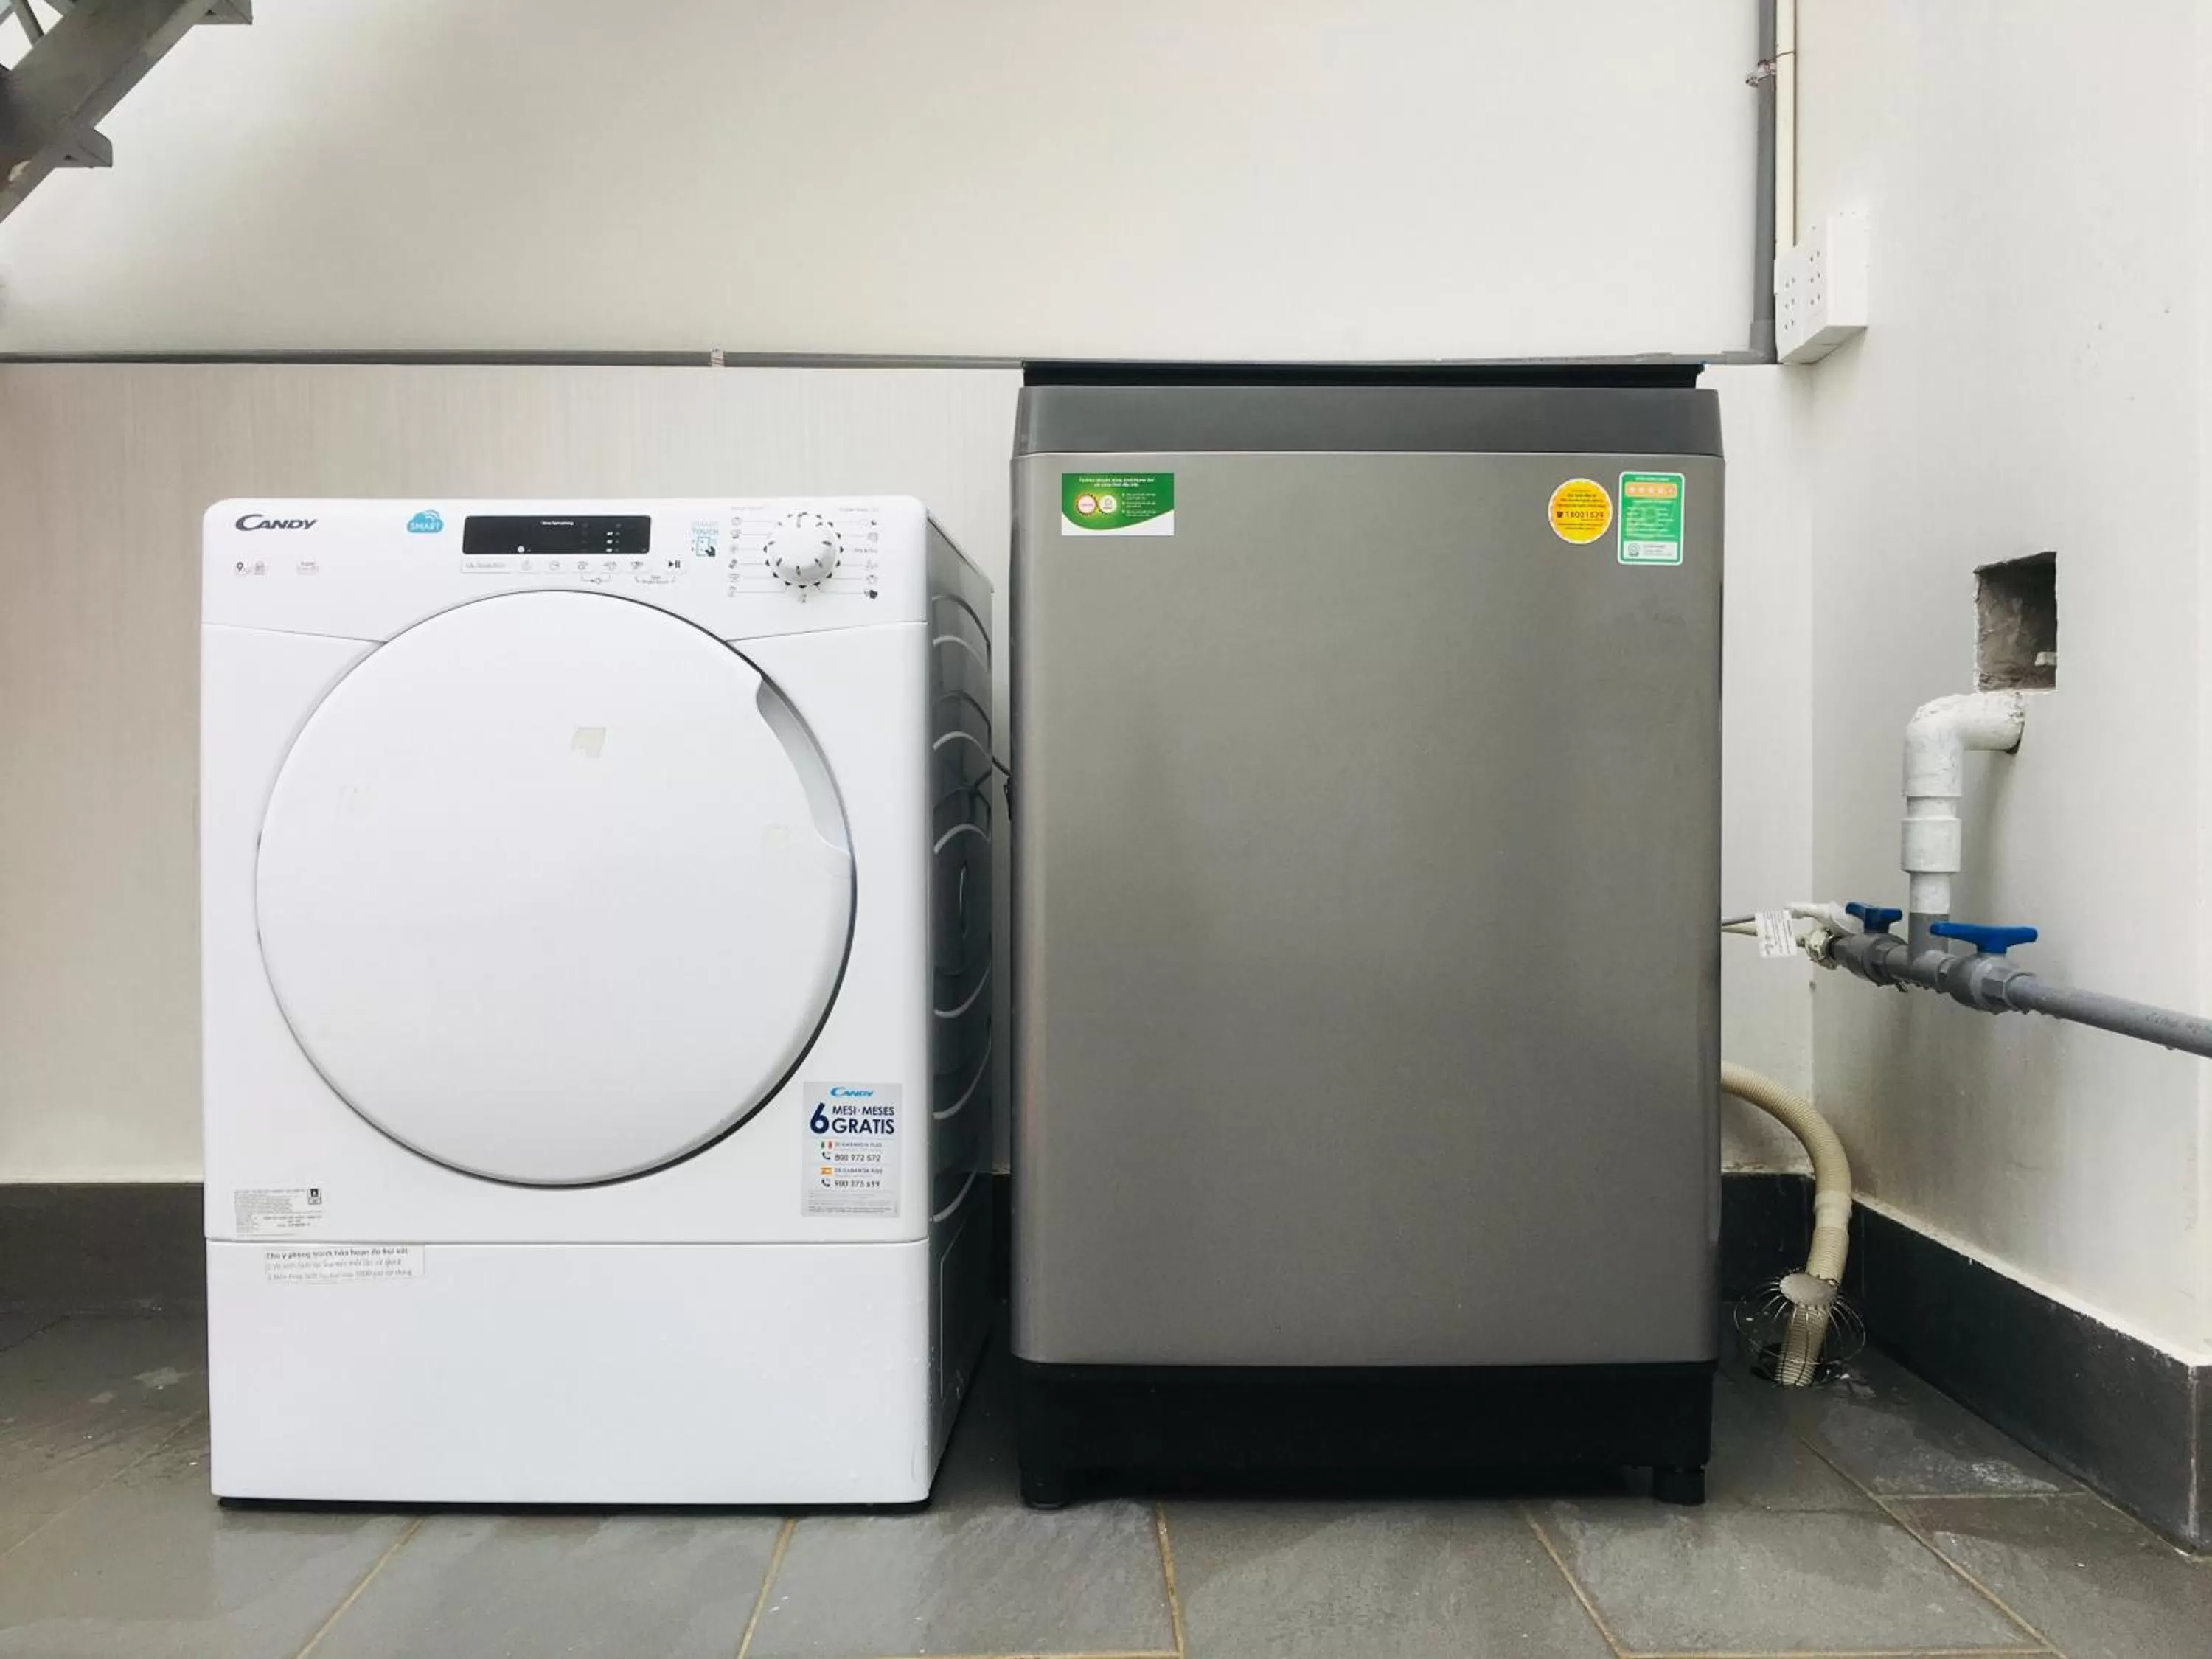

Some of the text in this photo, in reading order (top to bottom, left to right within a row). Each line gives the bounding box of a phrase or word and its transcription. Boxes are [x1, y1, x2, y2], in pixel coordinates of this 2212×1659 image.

[235, 514, 317, 531] CANDY
[410, 521, 440, 531] SMART
[830, 1087, 873, 1097] CANDY
[832, 1106, 894, 1116] MESI MESES
[810, 1102, 830, 1134] 6
[832, 1118, 894, 1134] GRATIS
